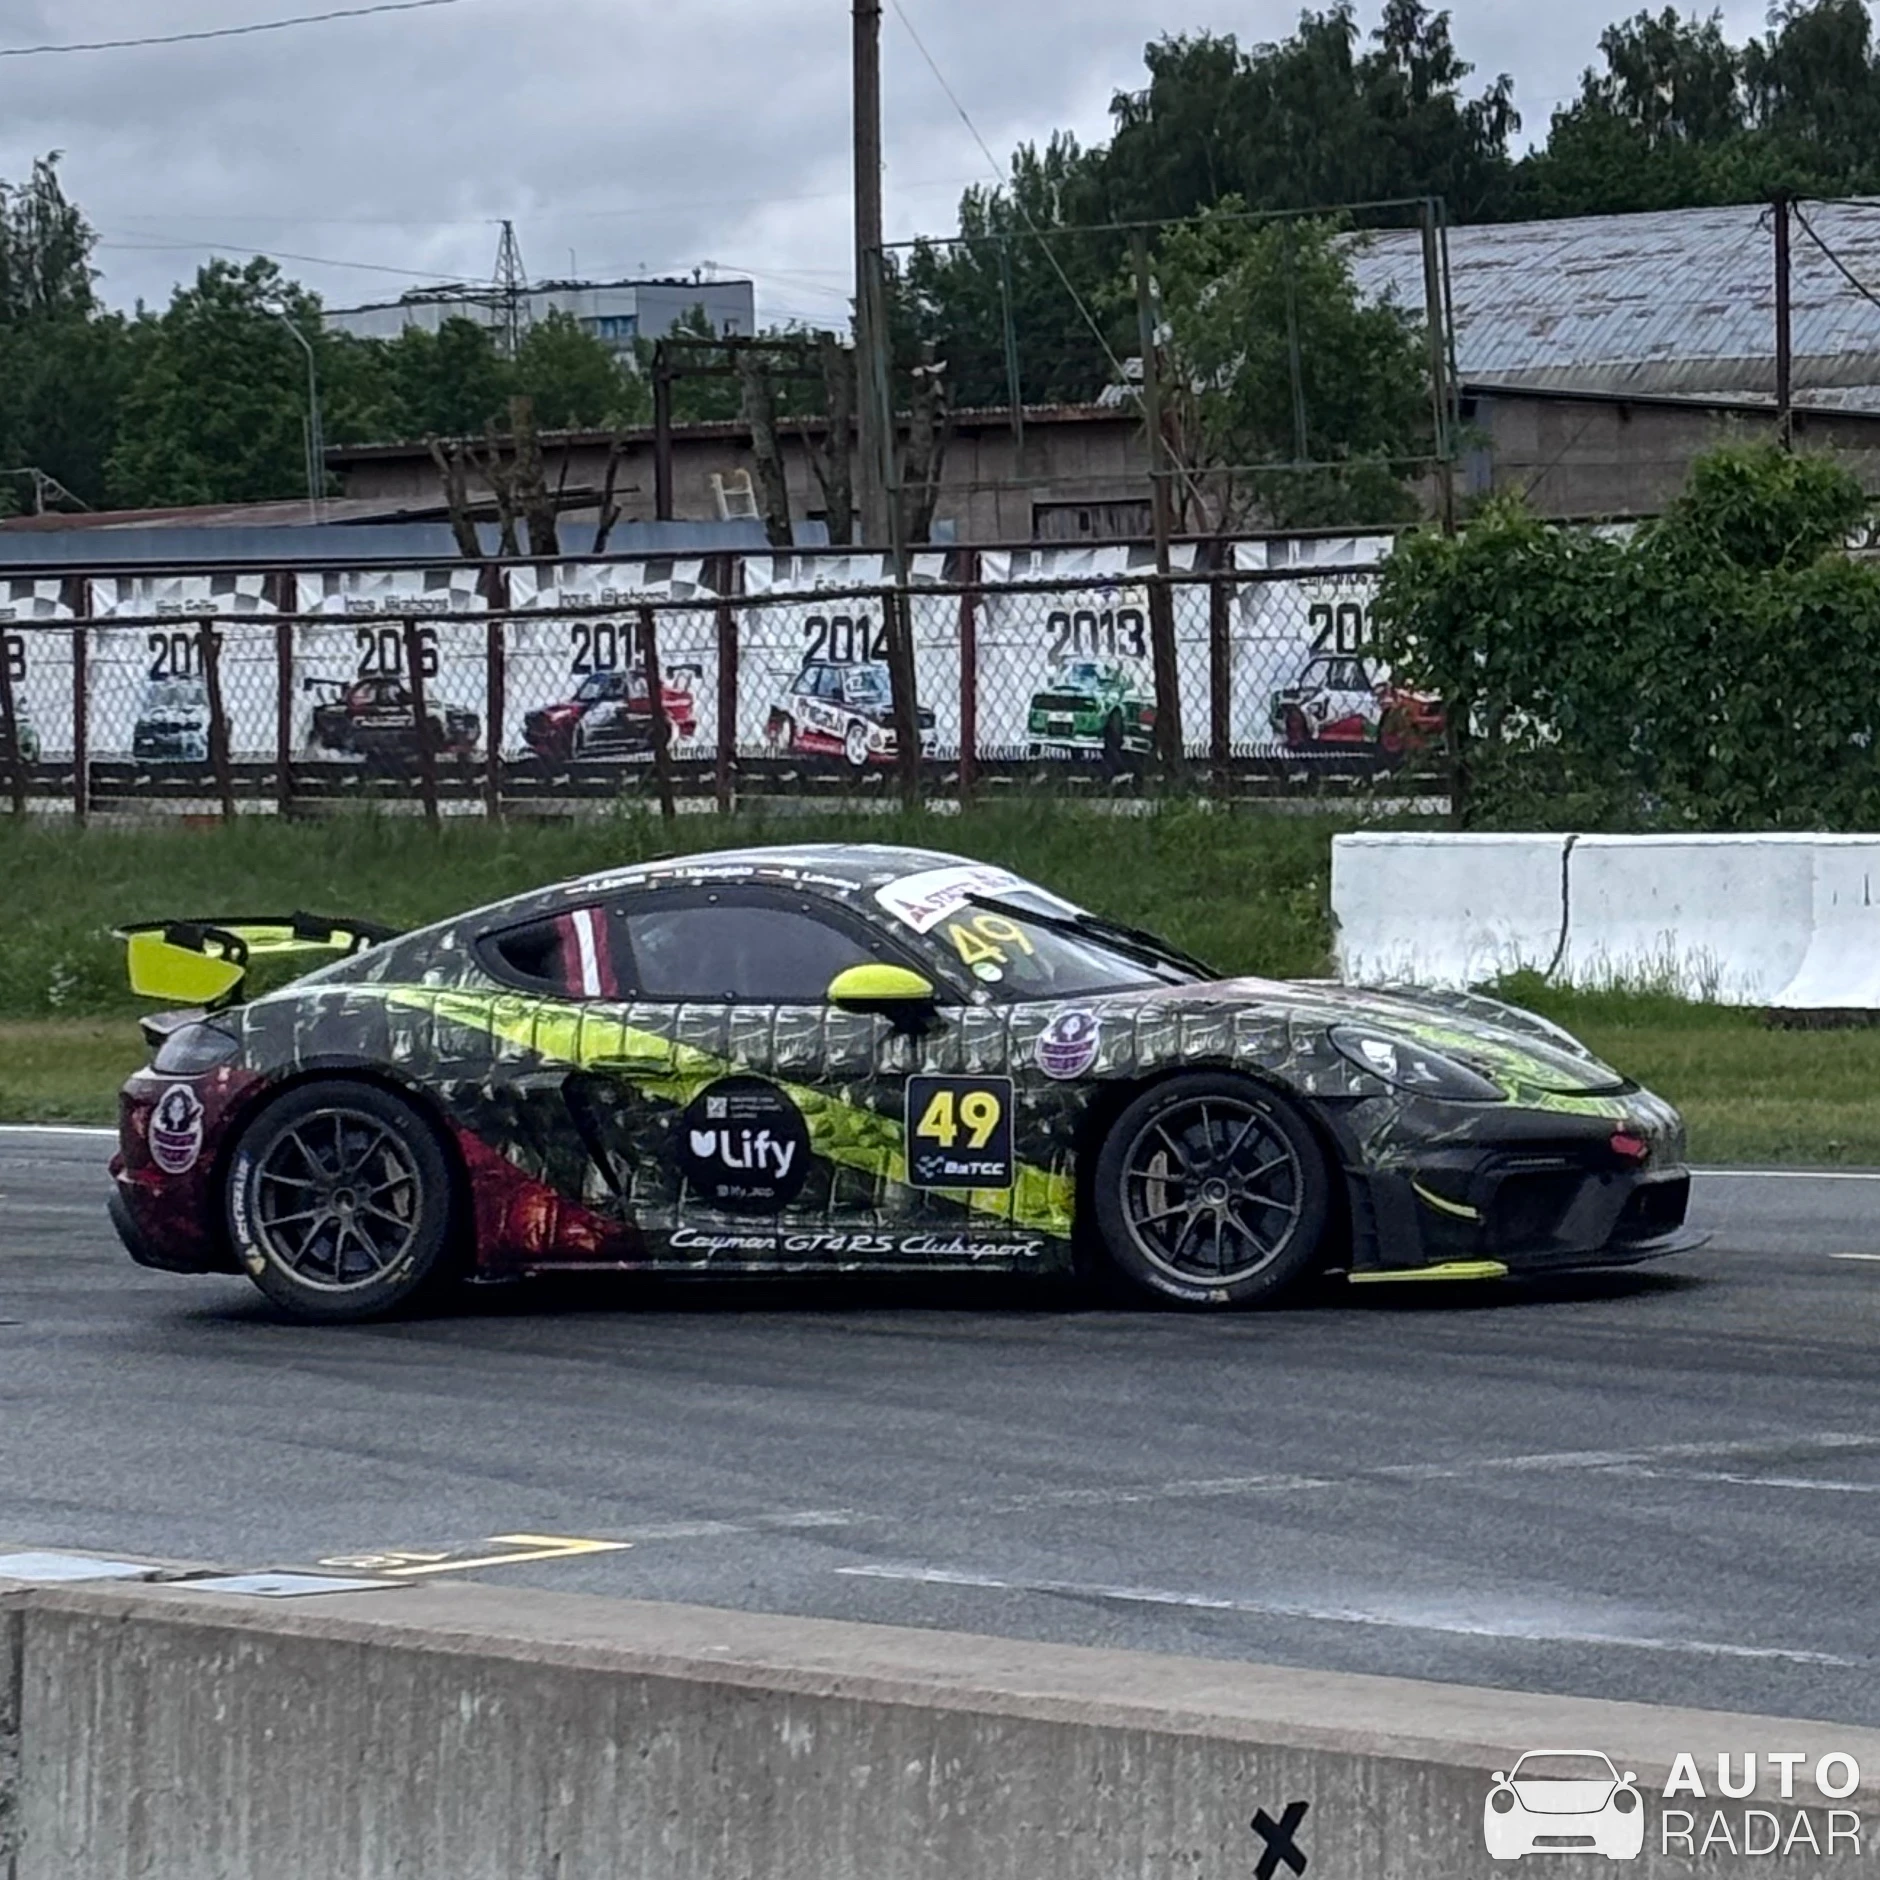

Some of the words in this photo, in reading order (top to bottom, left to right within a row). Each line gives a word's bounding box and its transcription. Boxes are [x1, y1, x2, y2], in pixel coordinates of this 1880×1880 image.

[149, 632, 223, 680] 201
[356, 628, 438, 678] 206
[1047, 608, 1145, 666] 2013
[949, 915, 1034, 965] 49
[916, 1090, 1000, 1149] 49
[720, 1129, 796, 1179] Lify
[669, 1228, 776, 1257] Cayman
[900, 1235, 1044, 1260] Clubsport
